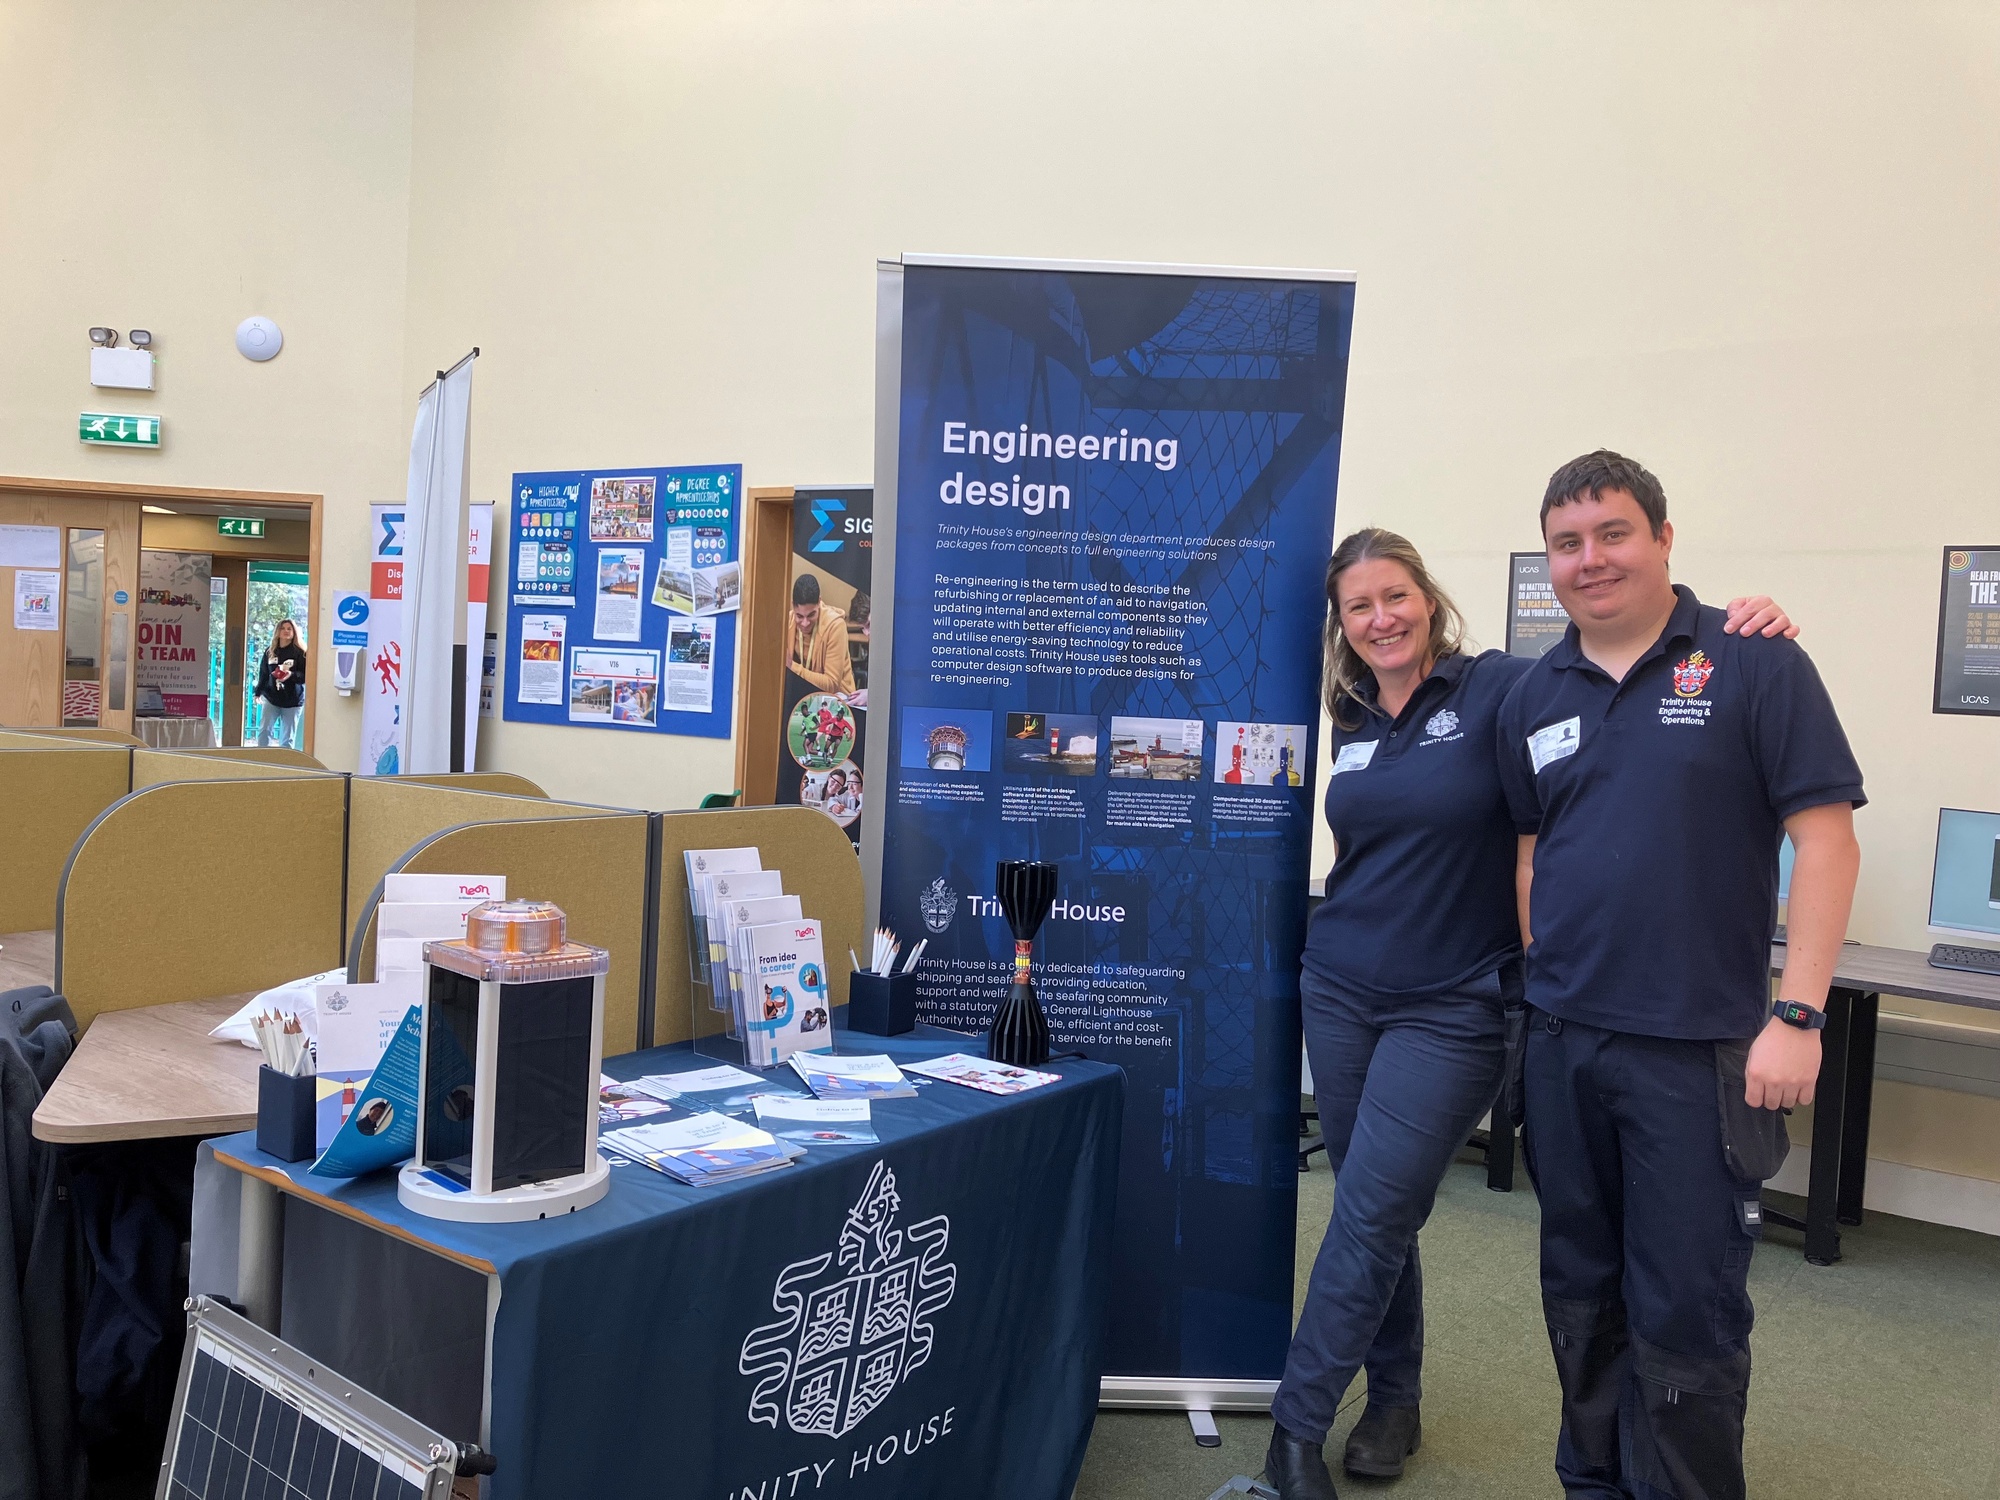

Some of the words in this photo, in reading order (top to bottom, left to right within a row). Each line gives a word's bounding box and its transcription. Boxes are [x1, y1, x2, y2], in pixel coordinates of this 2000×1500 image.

[942, 421, 1178, 471] Engineering
[687, 478, 710, 490] DEGREE
[539, 486, 559, 497] HIGHER
[676, 492, 720, 504] APPRENTICESHIPS
[939, 473, 1071, 515] design
[938, 523, 969, 536] Trinity
[971, 525, 1013, 537] House's
[1015, 528, 1078, 542] engineering
[1080, 530, 1116, 543] design
[1119, 532, 1182, 545] department
[1184, 535, 1236, 547] produces
[1238, 537, 1275, 550] design
[935, 538, 987, 551] packages
[990, 539, 1015, 551] from
[1017, 543, 1068, 554] concepts
[1071, 545, 1081, 554] to
[1084, 544, 1100, 555] full
[1102, 546, 1165, 560] engineering
[1167, 548, 1217, 560] solutions
[1970, 571, 1989, 581] HEAR
[935, 573, 1017, 589] Re-engineering
[1020, 578, 1029, 587] is
[1032, 578, 1049, 588] the
[1052, 579, 1078, 590] term
[1081, 581, 1107, 591] used
[1110, 582, 1120, 592] to
[1123, 582, 1169, 594] describe
[1172, 584, 1190, 595] the
[1519, 583, 1526, 591] NO
[1527, 583, 1546, 591] MATTER
[934, 588, 998, 603] refurbishing
[1015, 592, 1083, 604] replacement
[1086, 595, 1097, 604] of
[1116, 597, 1132, 606] aid
[1135, 598, 1145, 607] to
[1148, 599, 1207, 611] navigation,
[1541, 592, 1552, 600] YOU
[1970, 582, 1998, 604] THE
[933, 602, 981, 617] updating
[984, 604, 1025, 615] internal
[1028, 607, 1048, 616] and
[1051, 608, 1095, 619] external
[1097, 611, 1165, 622] components
[1168, 615, 1181, 623] so
[1184, 613, 1207, 626] they
[1545, 609, 1558, 617] NEXT
[138, 623, 182, 645] OIN
[933, 616, 950, 626] will
[953, 619, 994, 628] operate
[997, 619, 1019, 629] with
[1023, 620, 1055, 631] better
[1057, 622, 1110, 635] efficiency
[1113, 625, 1133, 634] and
[1136, 626, 1185, 639] reliability
[932, 630, 952, 640] and
[955, 631, 987, 642] utilise
[990, 634, 1066, 648] energy-saving
[1069, 637, 1129, 650] technology
[1132, 640, 1143, 649] to
[1145, 640, 1182, 651] reduce
[150, 647, 196, 661] TEAM
[931, 645, 992, 656] operational
[995, 648, 1027, 658] costs.
[1030, 648, 1063, 663] Trinity
[1065, 650, 1099, 661] House
[1102, 654, 1127, 662] uses
[1130, 653, 1156, 664] tools
[1159, 655, 1185, 665] such
[1188, 658, 1201, 666] as
[931, 660, 984, 670] computer
[986, 660, 1022, 673] design
[1025, 662, 1072, 674] software
[1074, 665, 1085, 674] to
[1088, 666, 1132, 677] produce
[1134, 667, 1177, 680] designs
[1180, 669, 1194, 679] for
[930, 673, 1011, 687] re-engineering.
[1661, 698, 1686, 707] Trinity
[1687, 698, 1712, 707] House
[1961, 695, 1989, 704] UCAS
[1659, 708, 1703, 717] Engineering
[1704, 708, 1711, 716] &
[1662, 716, 1705, 725] Operations
[1419, 738, 1442, 747] TRINITY
[1443, 732, 1464, 742] HOUSE
[1213, 796, 1253, 804] Computer-aided
[459, 885, 490, 895] neon
[1052, 900, 1126, 922] House
[795, 927, 815, 937] neon
[759, 956, 777, 964] From
[779, 952, 797, 962] idea
[760, 966, 768, 974] to
[769, 962, 795, 972] career
[918, 957, 949, 969] Trinity
[951, 958, 985, 969] House
[988, 959, 996, 969] is
[999, 962, 1005, 970] a
[1008, 962, 1045, 973] crity
[1047, 962, 1100, 974] dedicated
[1102, 965, 1113, 974] to
[1115, 965, 1184, 979] safeguarding
[916, 971, 961, 984] shipping
[964, 973, 984, 983] and
[1041, 976, 1089, 989] providing
[1092, 978, 1147, 990] education,
[915, 986, 957, 997] support
[959, 988, 980, 997] and
[1036, 989, 1053, 1000] the
[1055, 990, 1104, 1004] seafaring
[1107, 994, 1168, 1006] community
[915, 999, 937, 1009] with
[940, 1002, 946, 1010] a
[949, 1001, 997, 1013] statutory
[1041, 1005, 1047, 1013] a
[1050, 1004, 1090, 1015] General
[1093, 1005, 1152, 1018] Lighthouse
[379, 1019, 401, 1028] Your
[914, 1013, 963, 1026] Authority
[966, 1015, 976, 1025] to
[1068, 1018, 1111, 1030] efficient
[1114, 1021, 1133, 1031] and
[1136, 1023, 1163, 1032] cost-
[379, 1030, 389, 1038] of
[1057, 1033, 1095, 1043] service
[1098, 1033, 1112, 1044] for
[1115, 1034, 1132, 1045] the
[1135, 1035, 1171, 1046] benefit
[850, 1407, 956, 1478] HOUSE
